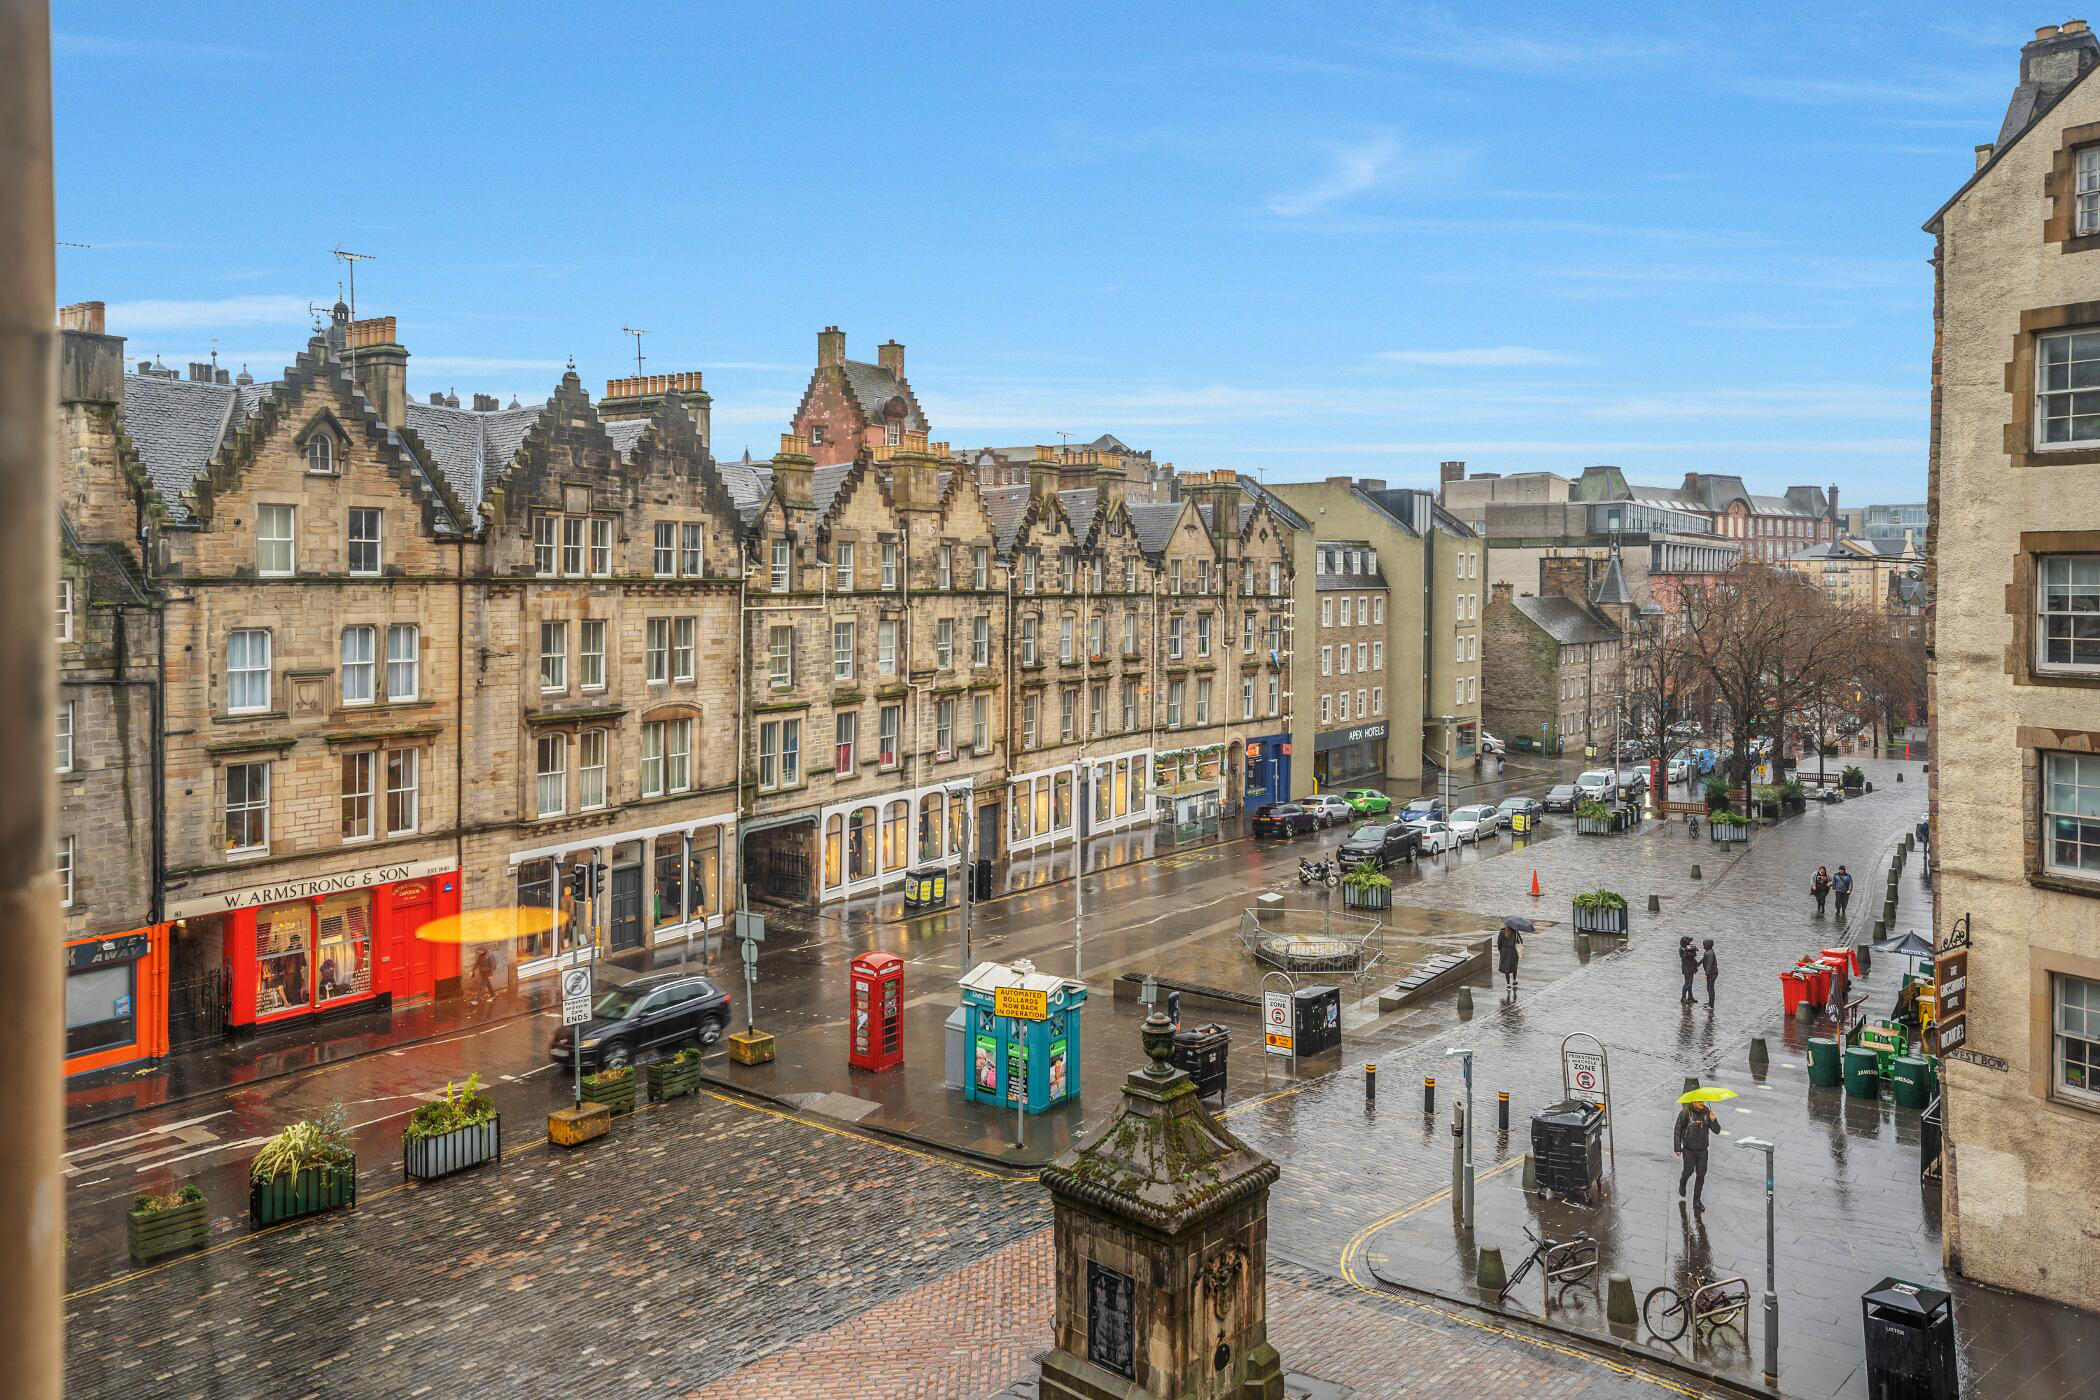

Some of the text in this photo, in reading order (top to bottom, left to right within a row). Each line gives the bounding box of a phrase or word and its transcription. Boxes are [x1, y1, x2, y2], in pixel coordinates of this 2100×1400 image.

[1348, 725, 1384, 742] APEX HOTELS
[224, 893, 244, 908] W.
[249, 875, 355, 905] ARMSTRONG
[363, 872, 372, 885] &
[379, 866, 409, 883] SON
[91, 946, 141, 963] AWAY
[1000, 990, 1042, 998] AUTOMATED
[1003, 996, 1038, 1004] BOLLARDS
[566, 1013, 588, 1023] ENDS
[1006, 1010, 1045, 1018] OPERATION
[1952, 1049, 2006, 1068] WEST BOW
[1574, 1064, 1596, 1072] ZONE
[1885, 1326, 1904, 1336] LITTER
